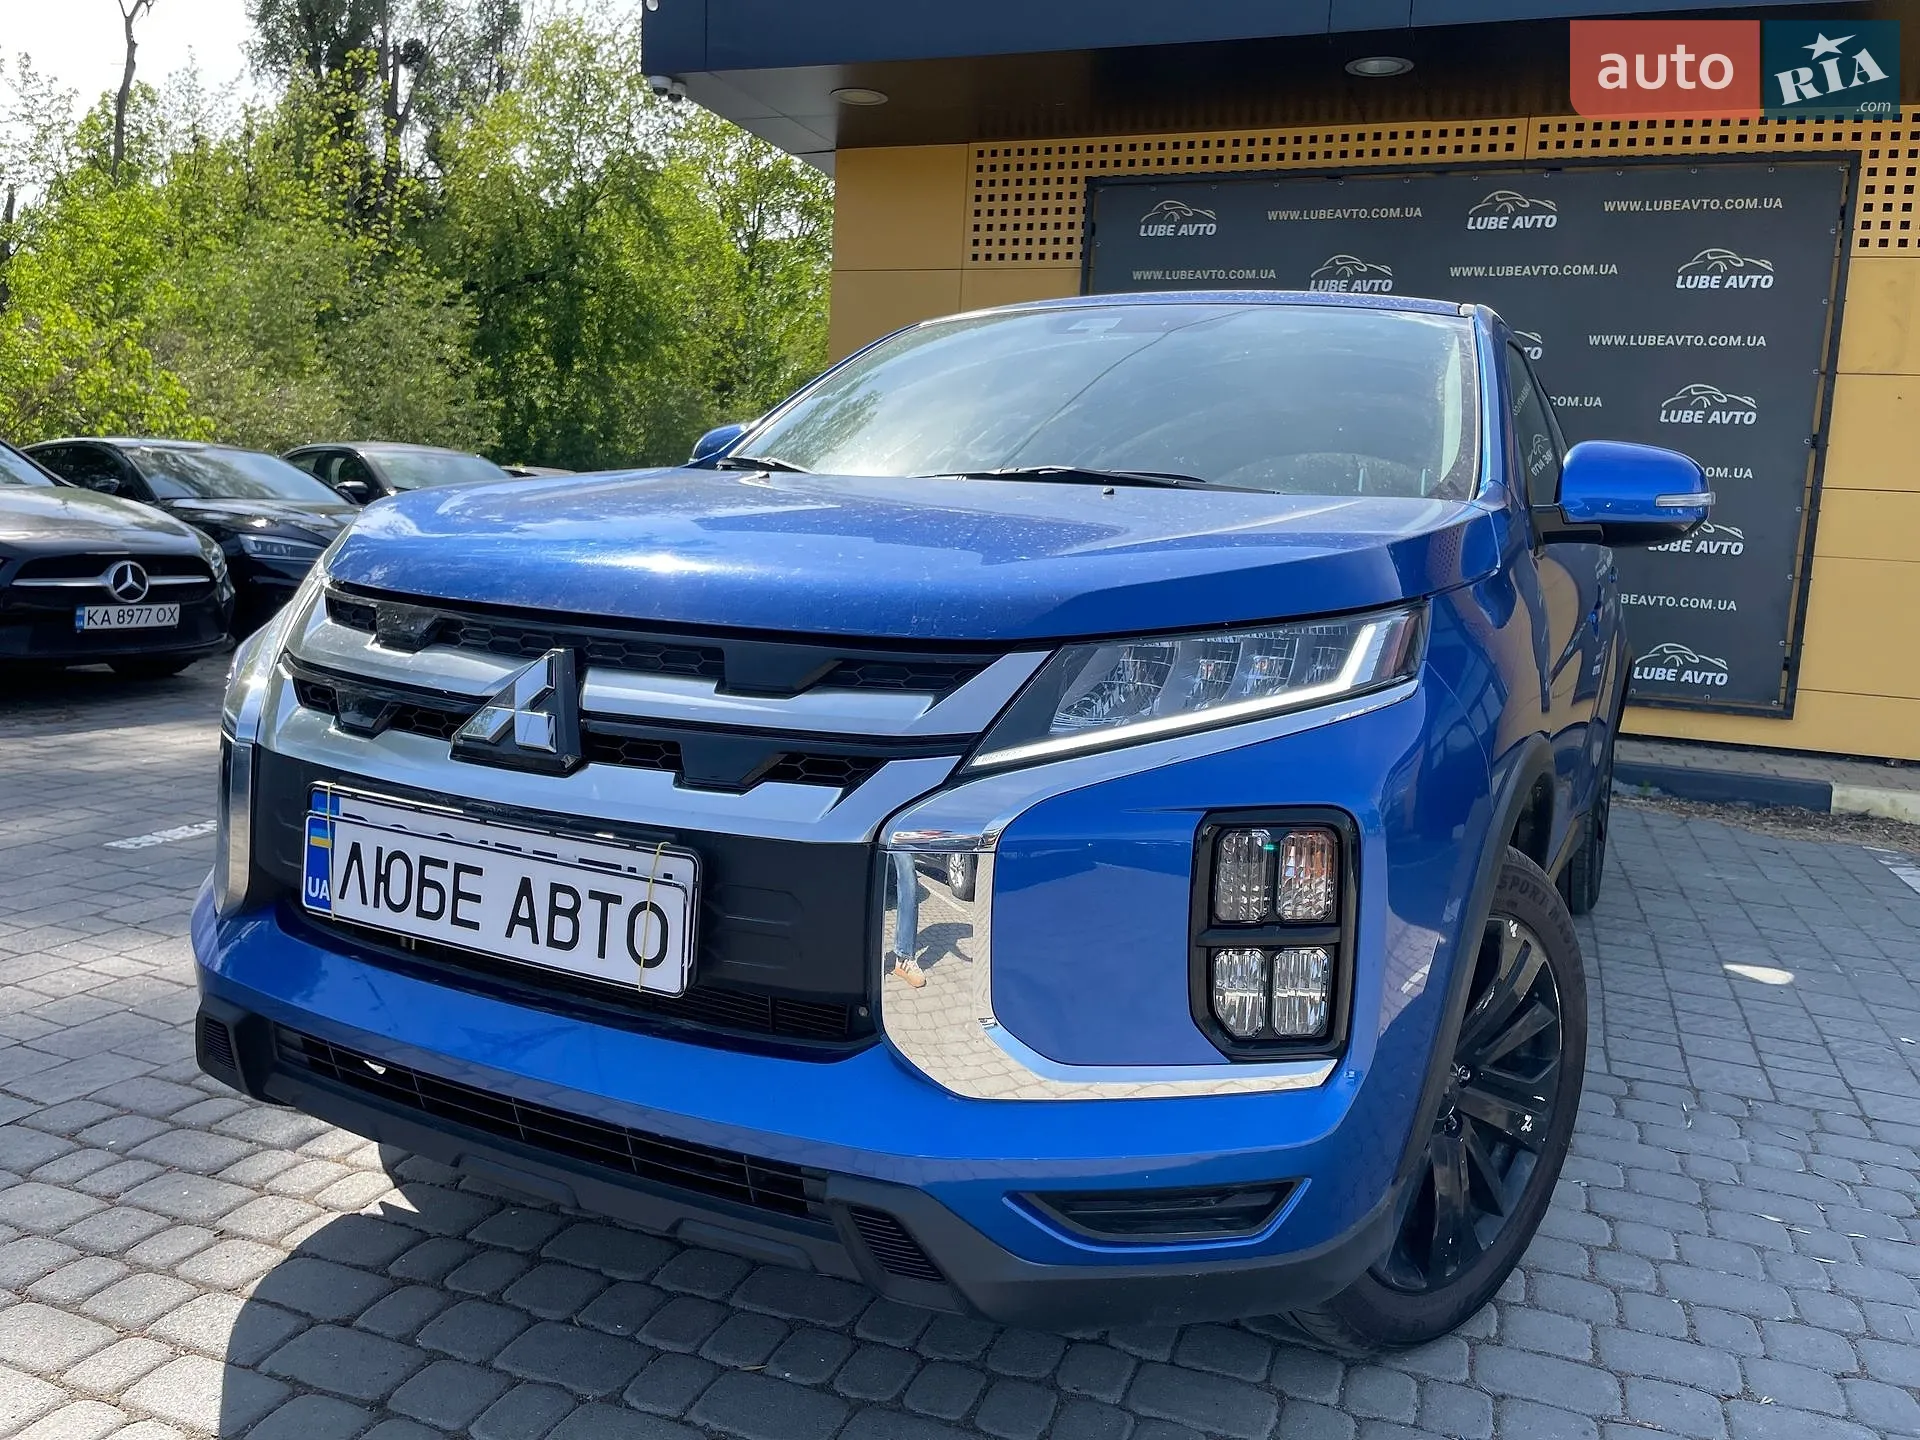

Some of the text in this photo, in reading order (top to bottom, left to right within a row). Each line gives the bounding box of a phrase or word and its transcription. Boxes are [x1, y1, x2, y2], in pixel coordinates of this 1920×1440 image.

[1604, 197, 1783, 212] WWW.LUBEAVTO.COM.UA
[1267, 207, 1423, 221] WWW.LUBEAVTO.COM.UA
[1466, 214, 1558, 230] LUBE AVTO
[1139, 222, 1217, 237] LUBE AVTO
[1132, 268, 1277, 281] WWW.LUBEAVTO.COM.UA
[1449, 263, 1618, 277] WWW.LUBEAVTO.COM.UA
[1309, 279, 1393, 293] LUBE AVTO
[1675, 274, 1774, 290] LUBE AVTO
[1588, 334, 1767, 347] WWW.LUBEAVTO.COM.UA
[1659, 409, 1757, 425] LUBE AVTO
[1704, 466, 1753, 479] OM.UA
[1695, 540, 1744, 556] AVTO
[1619, 593, 1737, 611] BEAVTO.COM.UA
[87, 609, 112, 626] KA
[116, 608, 153, 625] 8977
[156, 606, 178, 623] OX
[1633, 666, 1728, 686] LUBE AVTO
[307, 874, 331, 901] UA
[338, 840, 484, 932] ЛЮБЕ
[505, 876, 669, 969] АВТО
